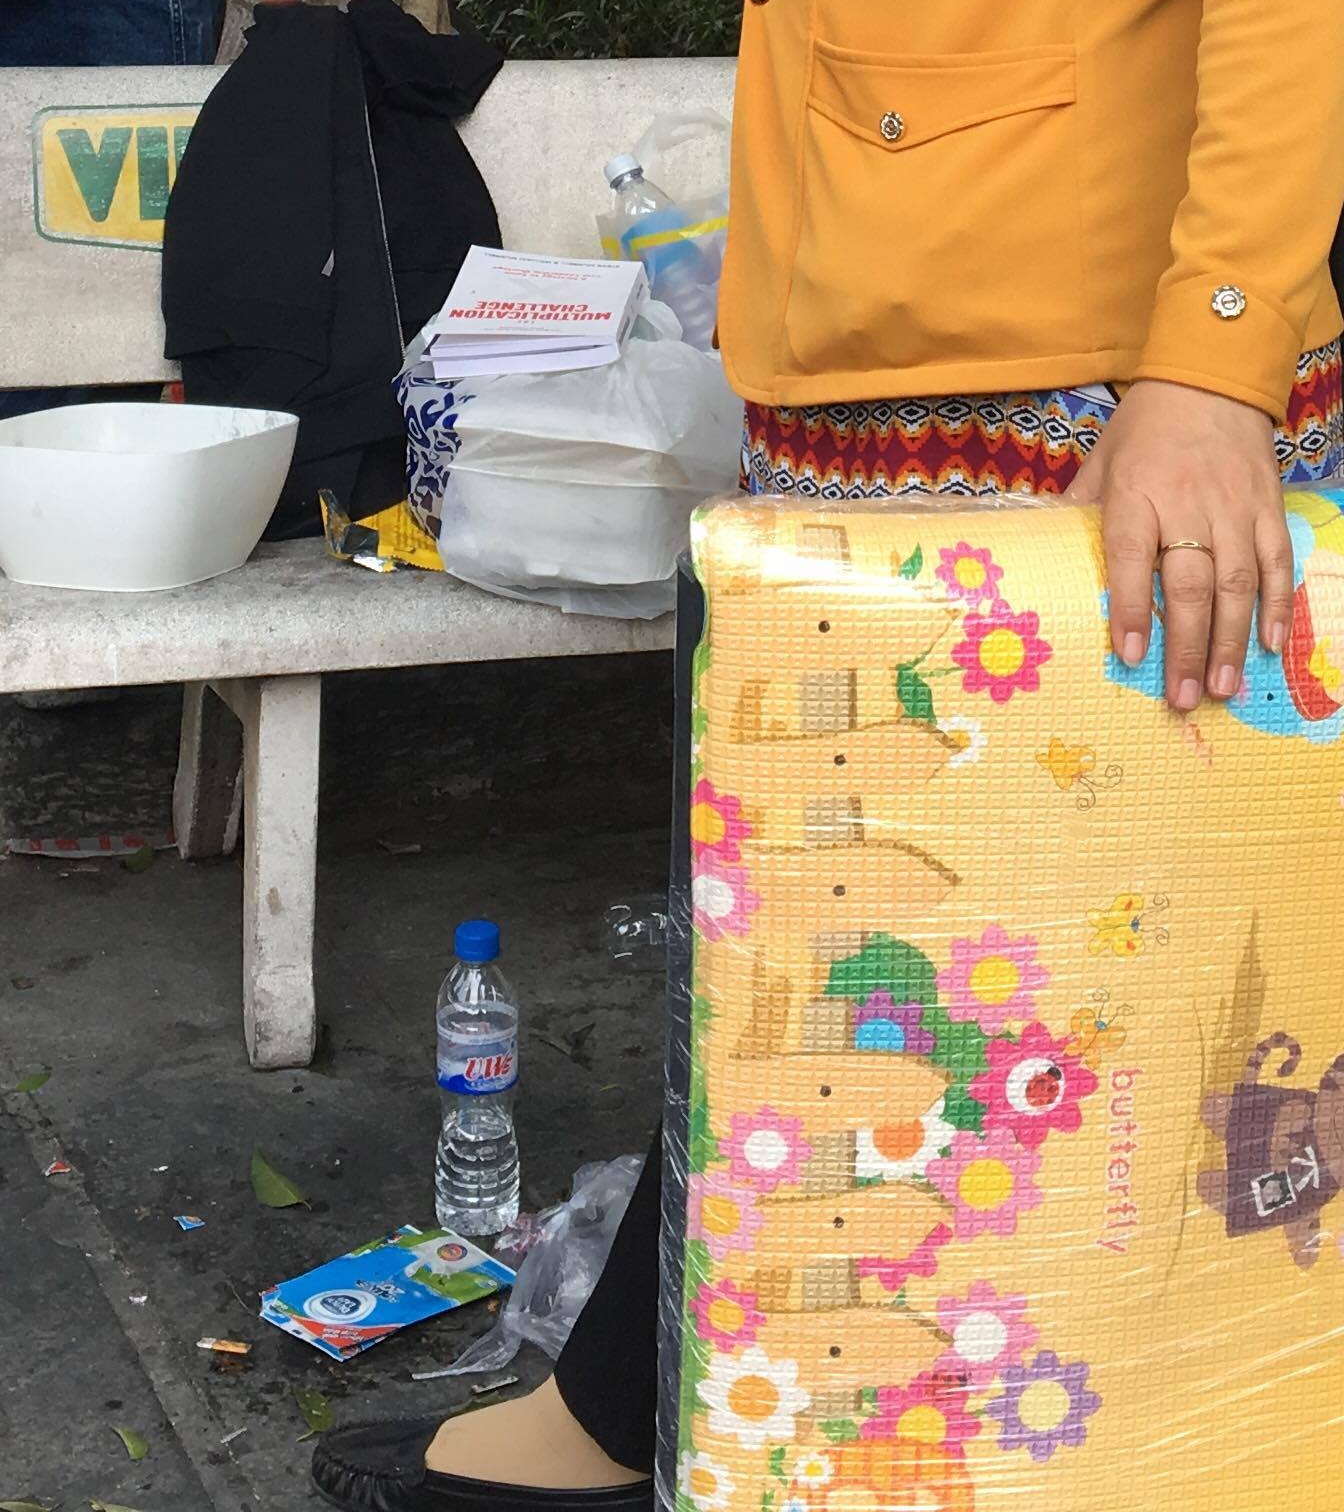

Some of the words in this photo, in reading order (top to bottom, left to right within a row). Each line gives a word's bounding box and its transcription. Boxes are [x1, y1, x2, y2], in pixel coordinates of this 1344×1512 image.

[475, 301, 589, 312] CHALLENGE
[449, 309, 612, 321] MULTIPLICATION
[1101, 1068, 1142, 1254] butterfly
